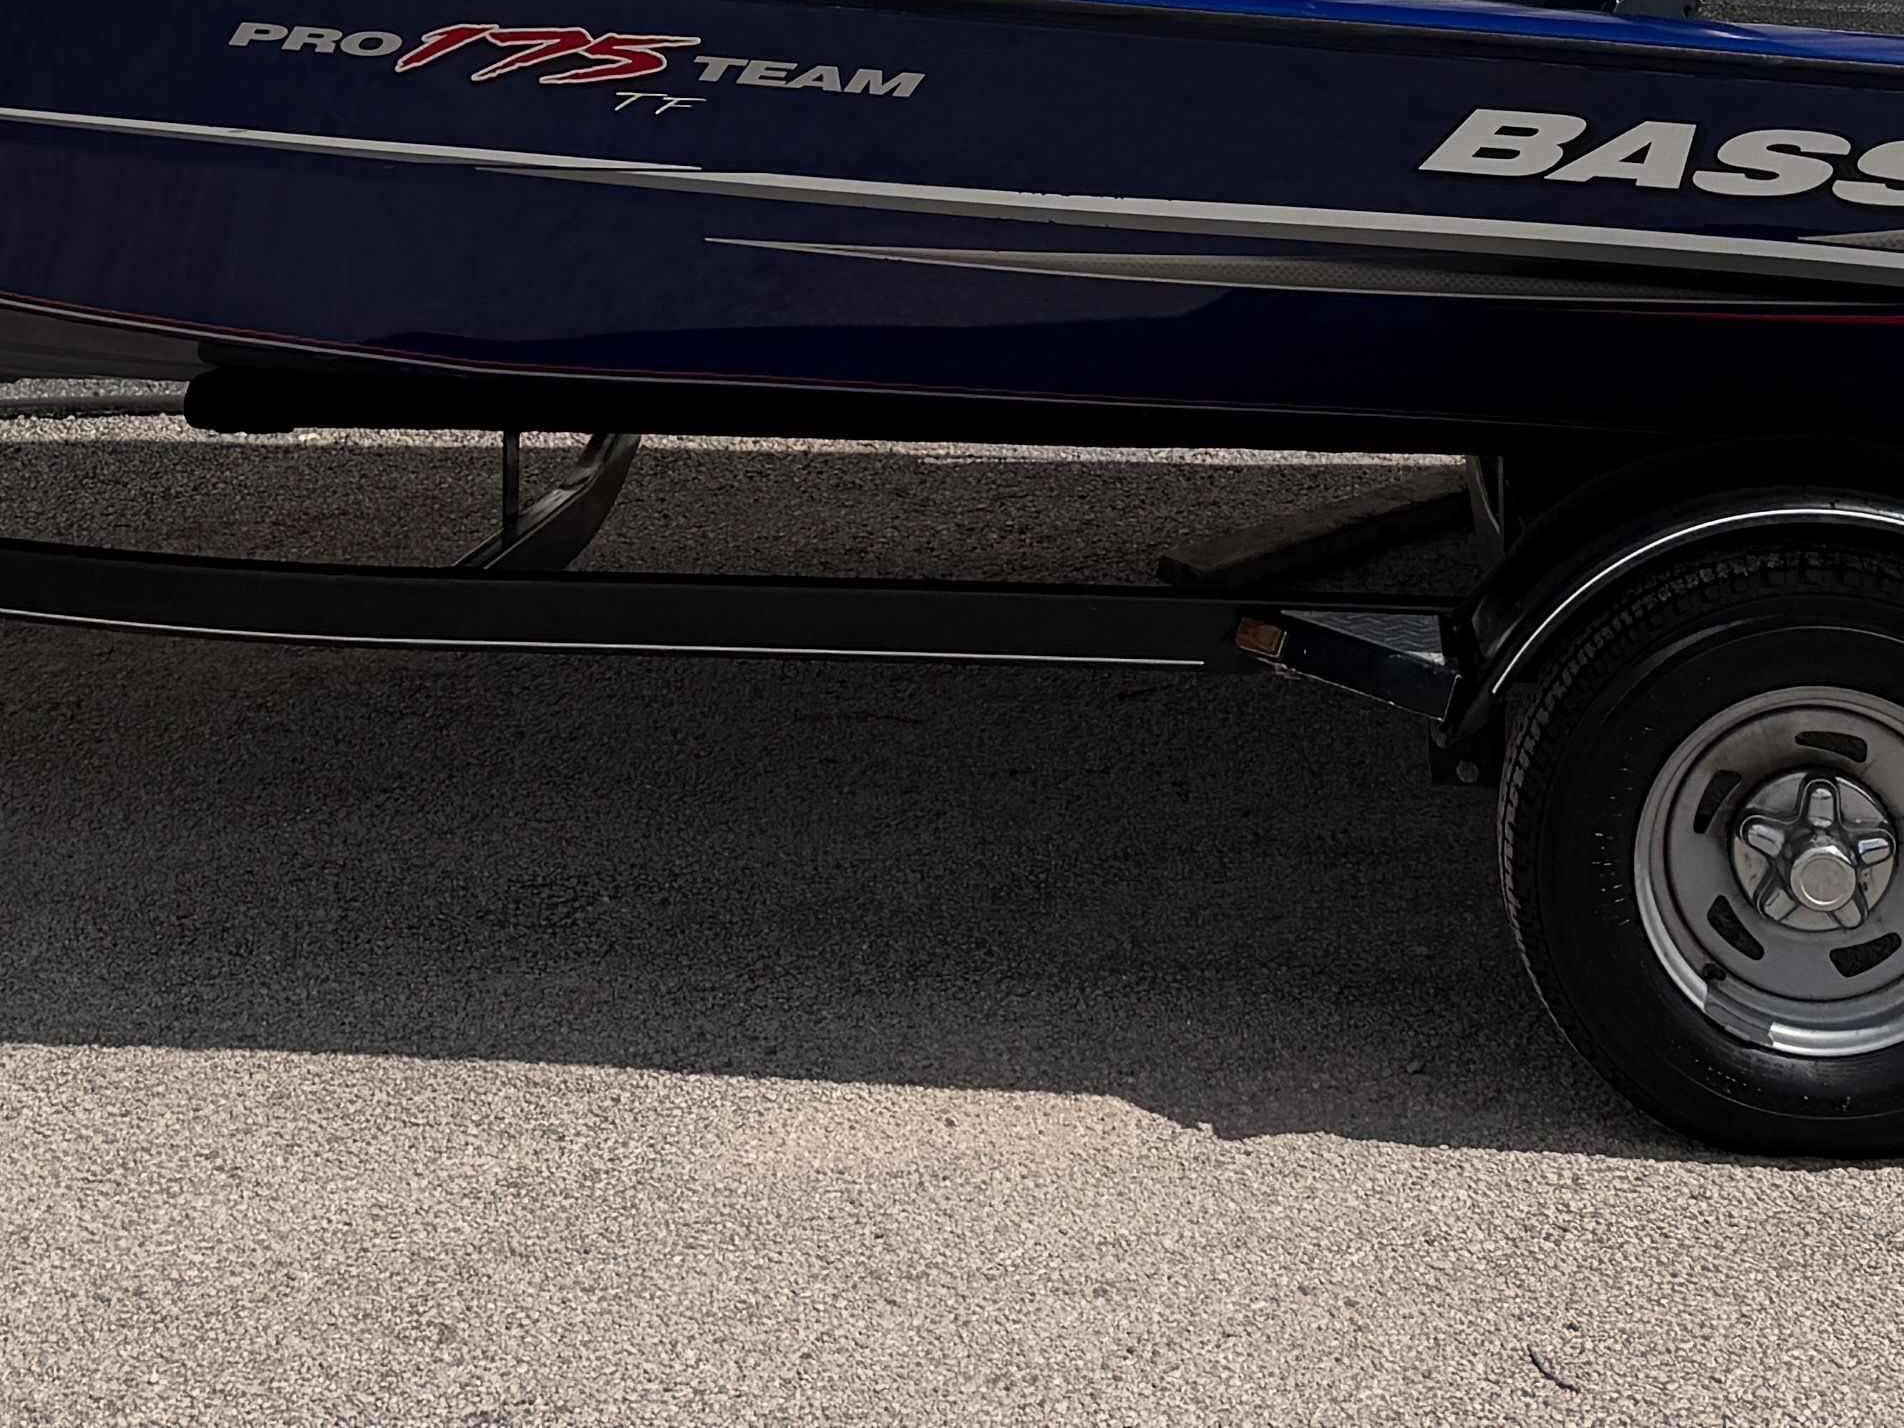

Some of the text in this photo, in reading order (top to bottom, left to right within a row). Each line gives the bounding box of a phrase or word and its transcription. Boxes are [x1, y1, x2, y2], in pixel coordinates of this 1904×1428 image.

[228, 21, 926, 98] PRO 175 TEAM
